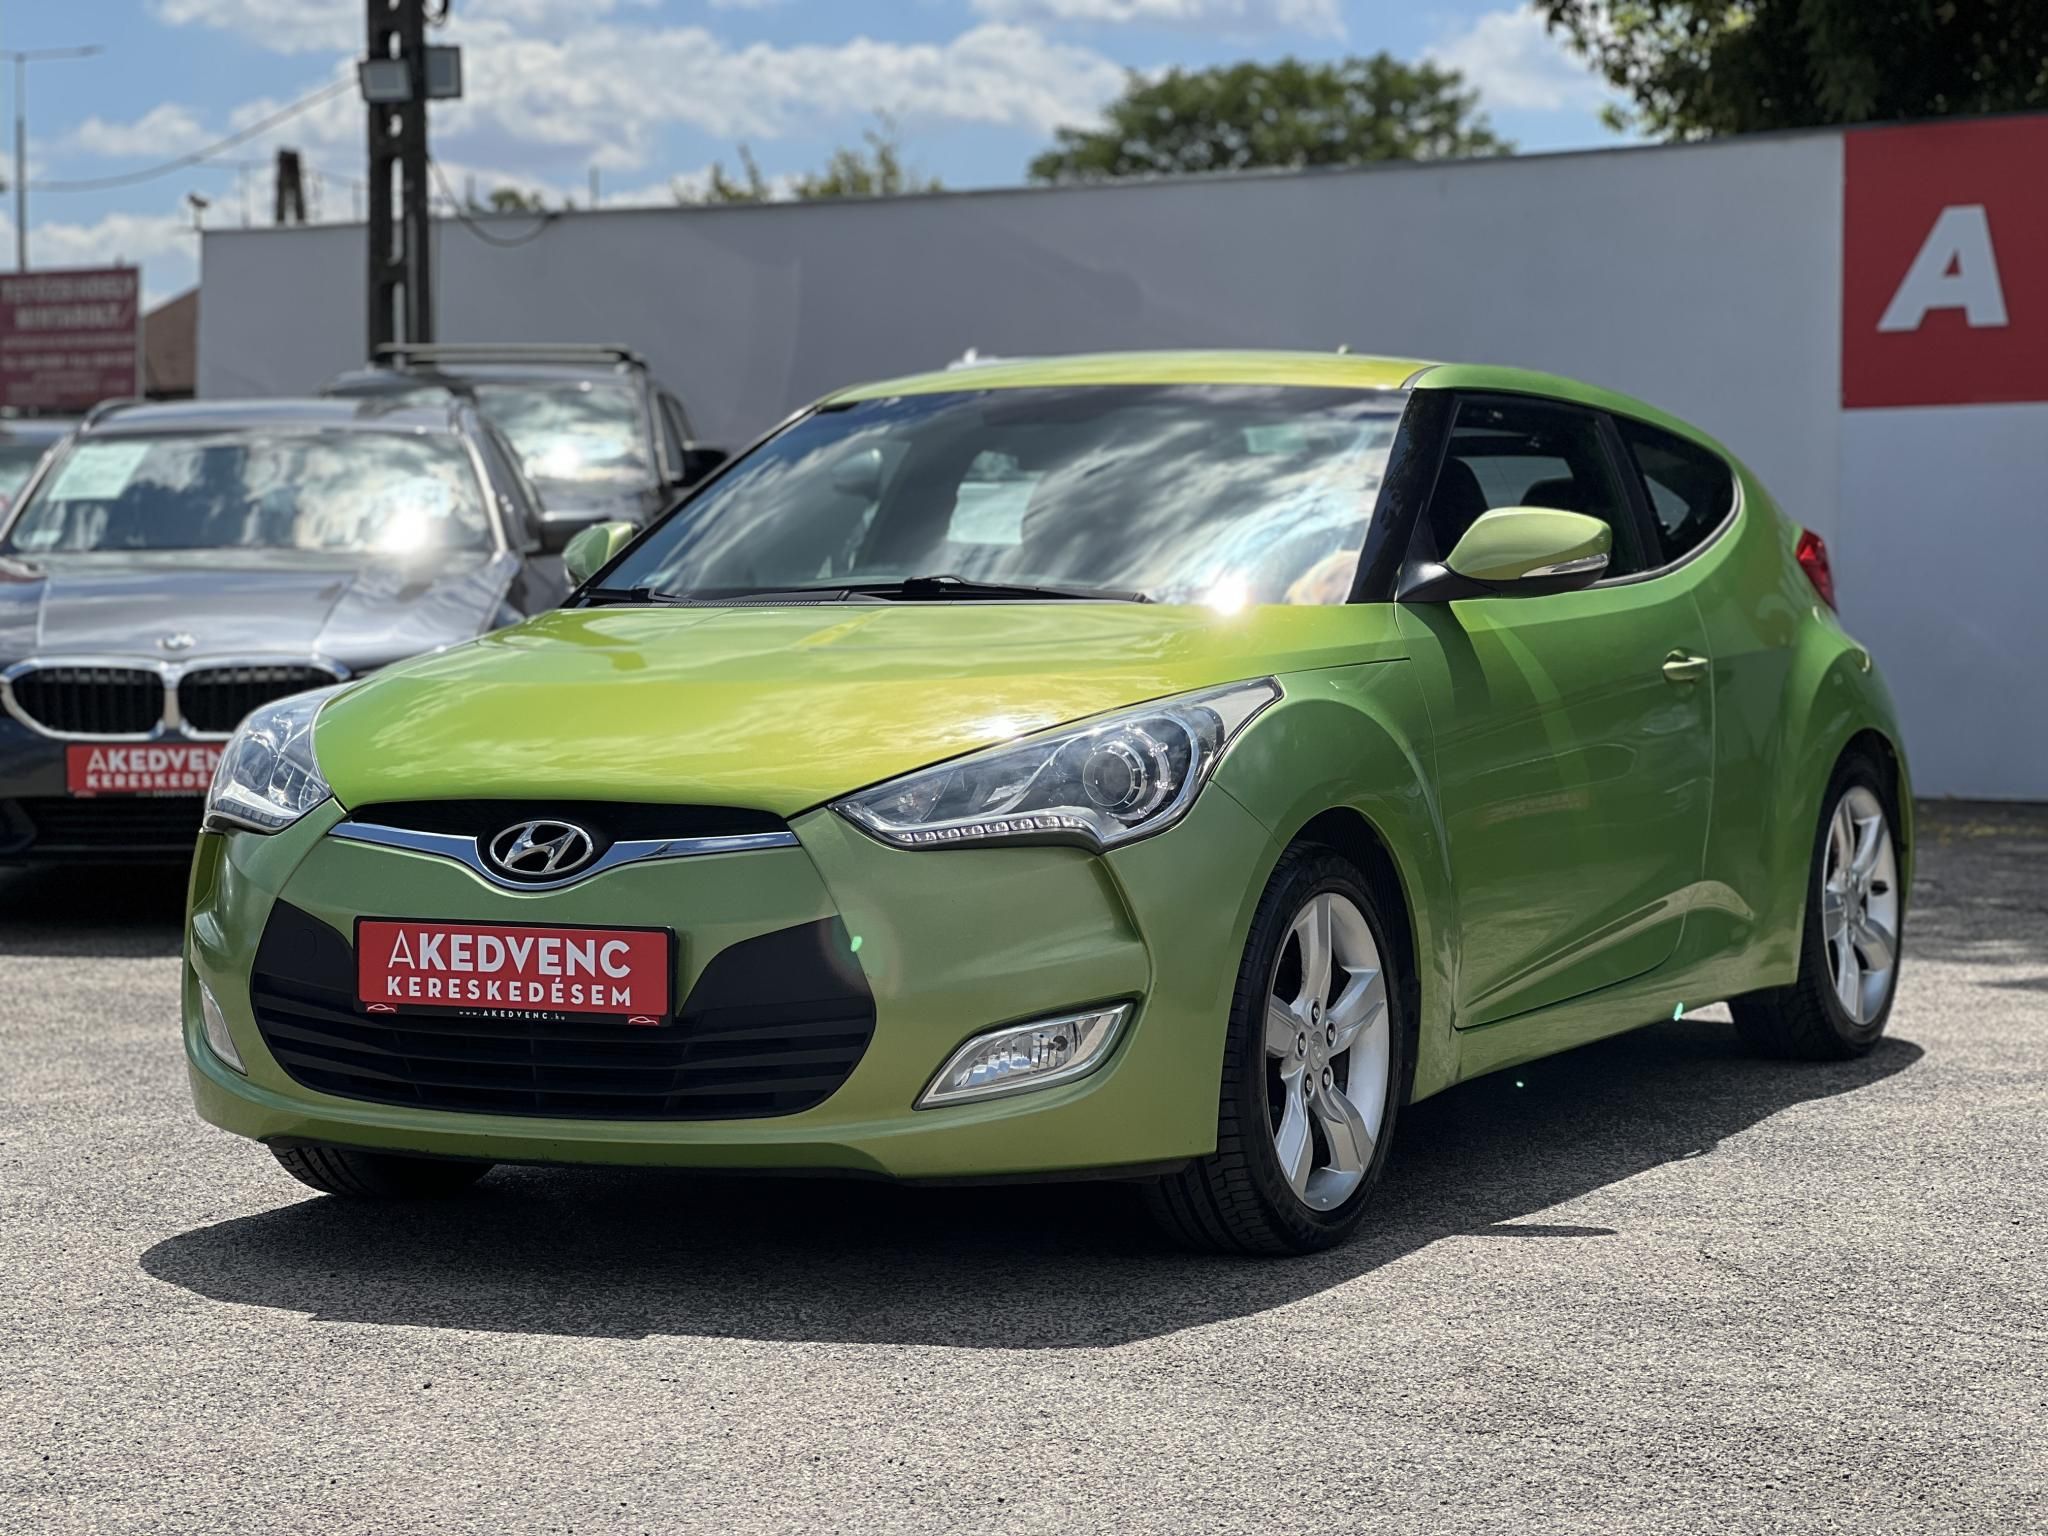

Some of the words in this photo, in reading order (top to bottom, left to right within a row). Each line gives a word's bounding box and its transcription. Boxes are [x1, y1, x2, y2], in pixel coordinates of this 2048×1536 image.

[1876, 204, 2009, 333] A
[87, 748, 222, 772] AKEDVEN
[388, 929, 631, 979] AKEDVENC
[387, 976, 631, 1007] KERESKEDÉSEM
